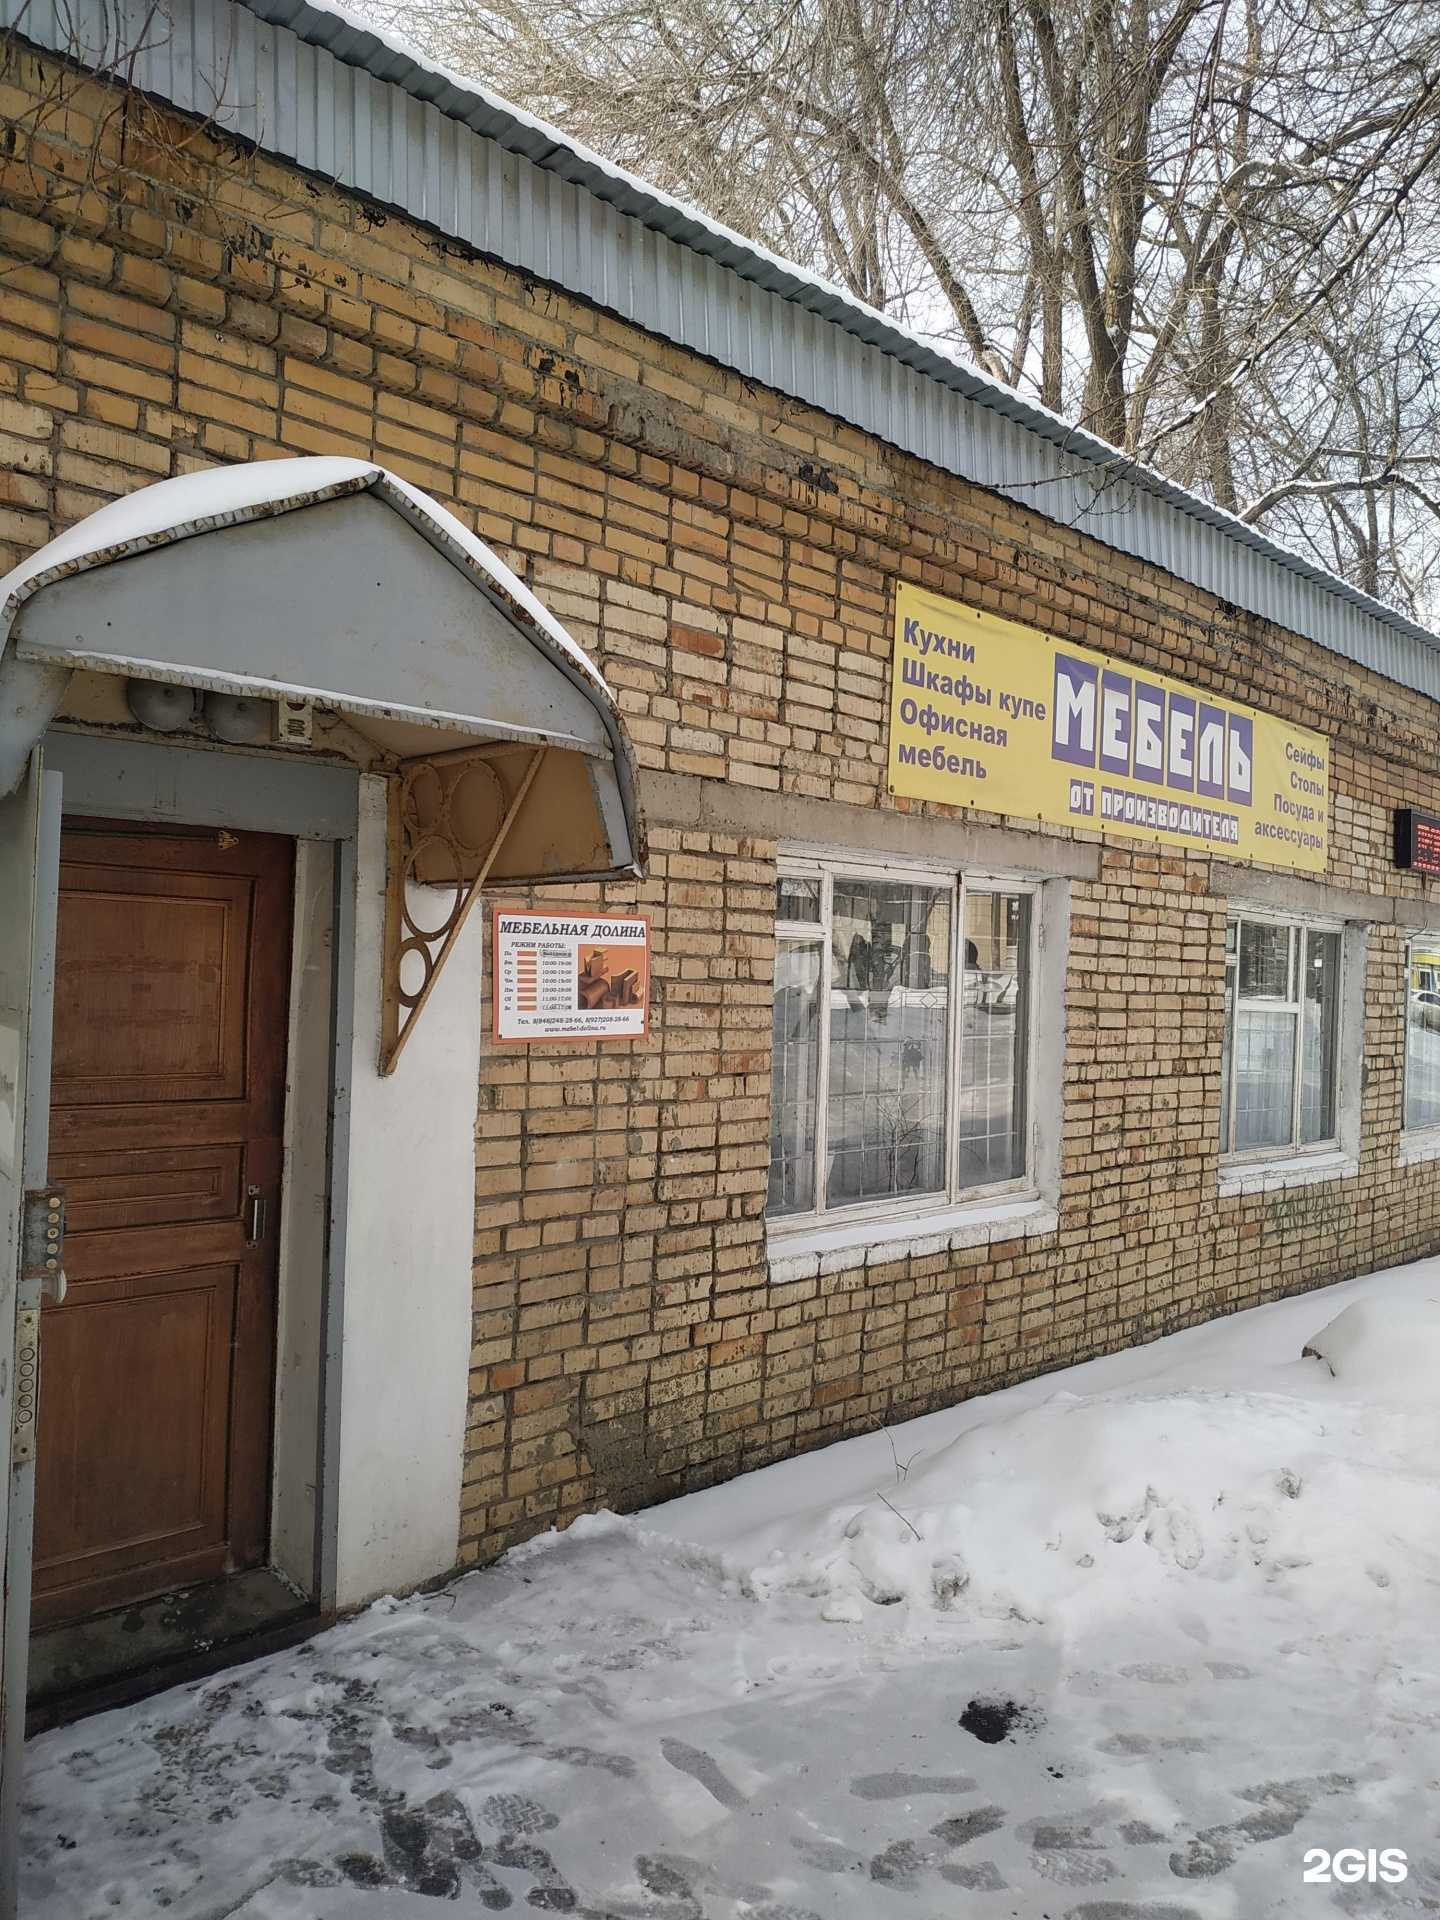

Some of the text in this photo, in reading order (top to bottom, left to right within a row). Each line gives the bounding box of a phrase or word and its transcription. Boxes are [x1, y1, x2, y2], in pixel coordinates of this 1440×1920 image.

[903, 617, 975, 662] Кухни
[902, 659, 1046, 722] Шкафы купе
[900, 699, 1008, 747] Офисная
[1054, 672, 1252, 792] МЕБЕЛЬ
[898, 744, 987, 778] мебель
[1285, 742, 1325, 771] Сейфы
[1290, 771, 1324, 796] Столы
[1070, 782, 1239, 843] ОТ ПРОИЗВОДИТЕЛЯ
[1274, 794, 1324, 823] Посуда и
[1254, 822, 1323, 850] аксессуары
[500, 921, 645, 938] МЕБЕЛЬНАЯ ДОЛИНА
